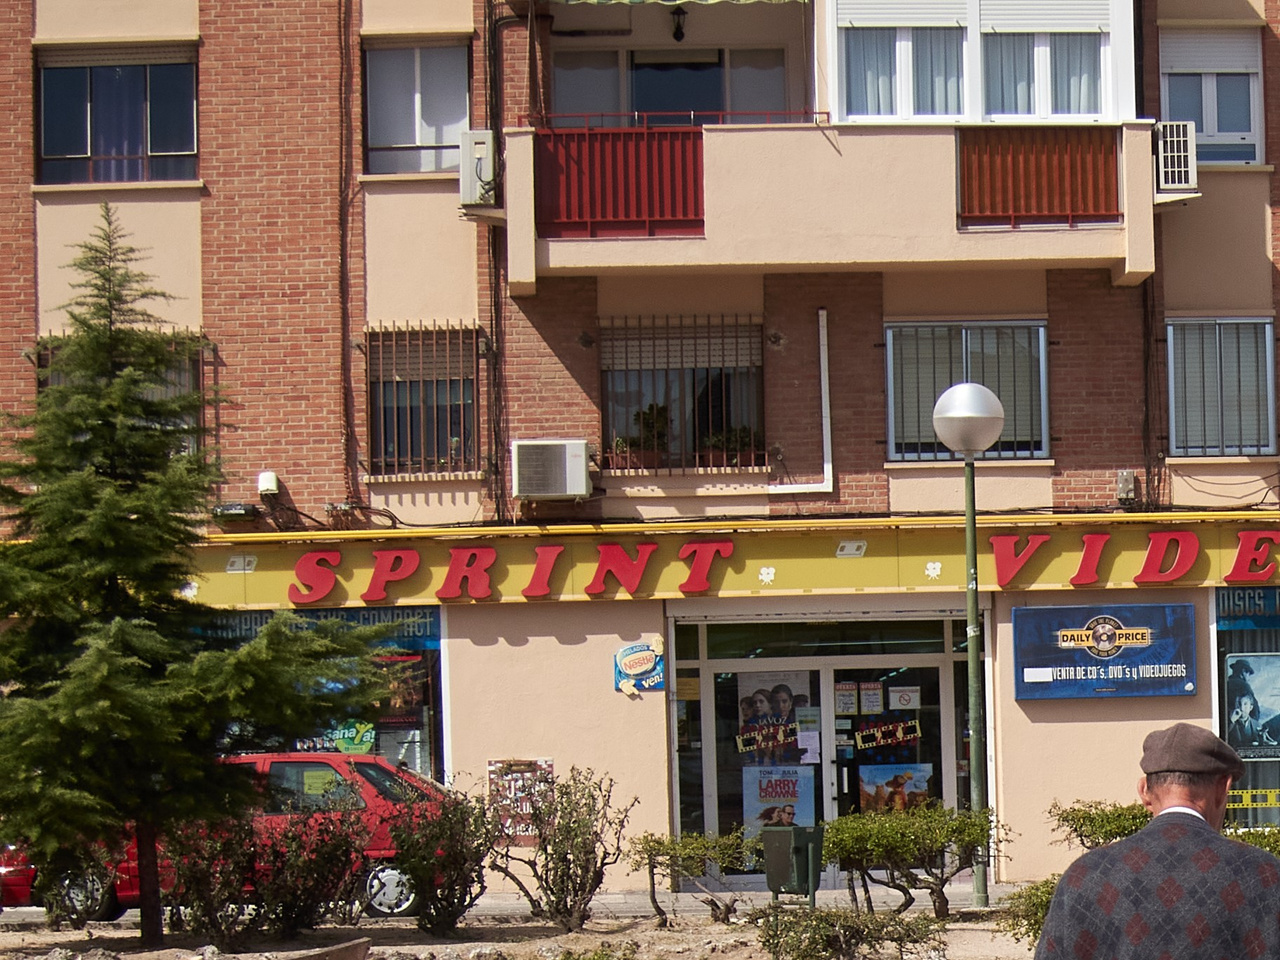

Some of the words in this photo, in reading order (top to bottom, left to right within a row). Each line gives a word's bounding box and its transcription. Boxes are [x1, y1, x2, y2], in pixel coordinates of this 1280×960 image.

[288, 541, 734, 604] SPRINT
[1062, 633, 1091, 642] DAILY
[1118, 632, 1147, 641] PRICE
[1052, 667, 1075, 680] VENTA
[1076, 666, 1086, 679] DE
[1138, 664, 1187, 677] VIDEOJUEGOS
[759, 779, 799, 791] LARRY
[760, 789, 799, 798] CROWNE
